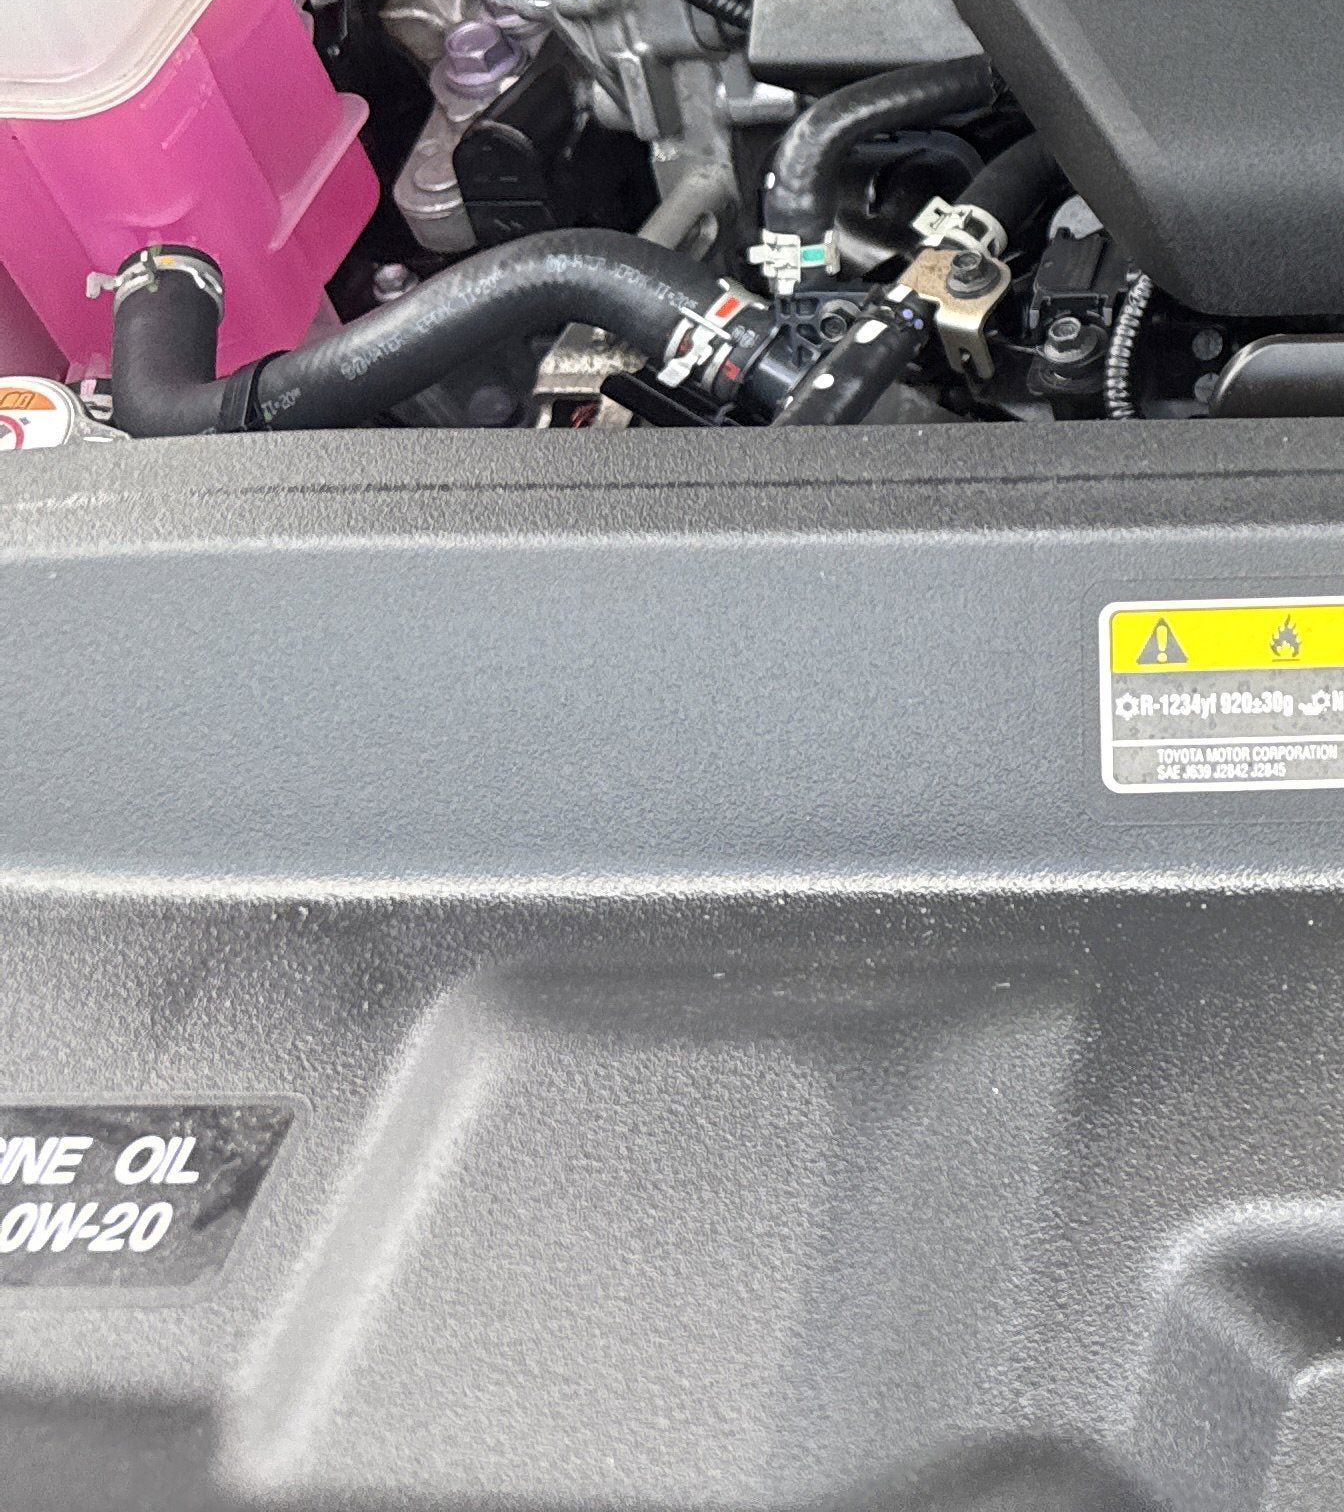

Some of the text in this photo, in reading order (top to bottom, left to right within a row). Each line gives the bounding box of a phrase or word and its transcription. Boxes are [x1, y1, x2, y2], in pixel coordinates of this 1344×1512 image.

[1140, 692, 1217, 719] R-1234yf
[1220, 691, 1294, 717] 920±30g
[1157, 744, 1338, 764] TOYOTA MOTOR CORPORATION
[1157, 761, 1286, 780] SAE J639 J2842 J2845
[0, 1135, 200, 1186] INE OIL
[0, 1201, 174, 1253] 0W-20
